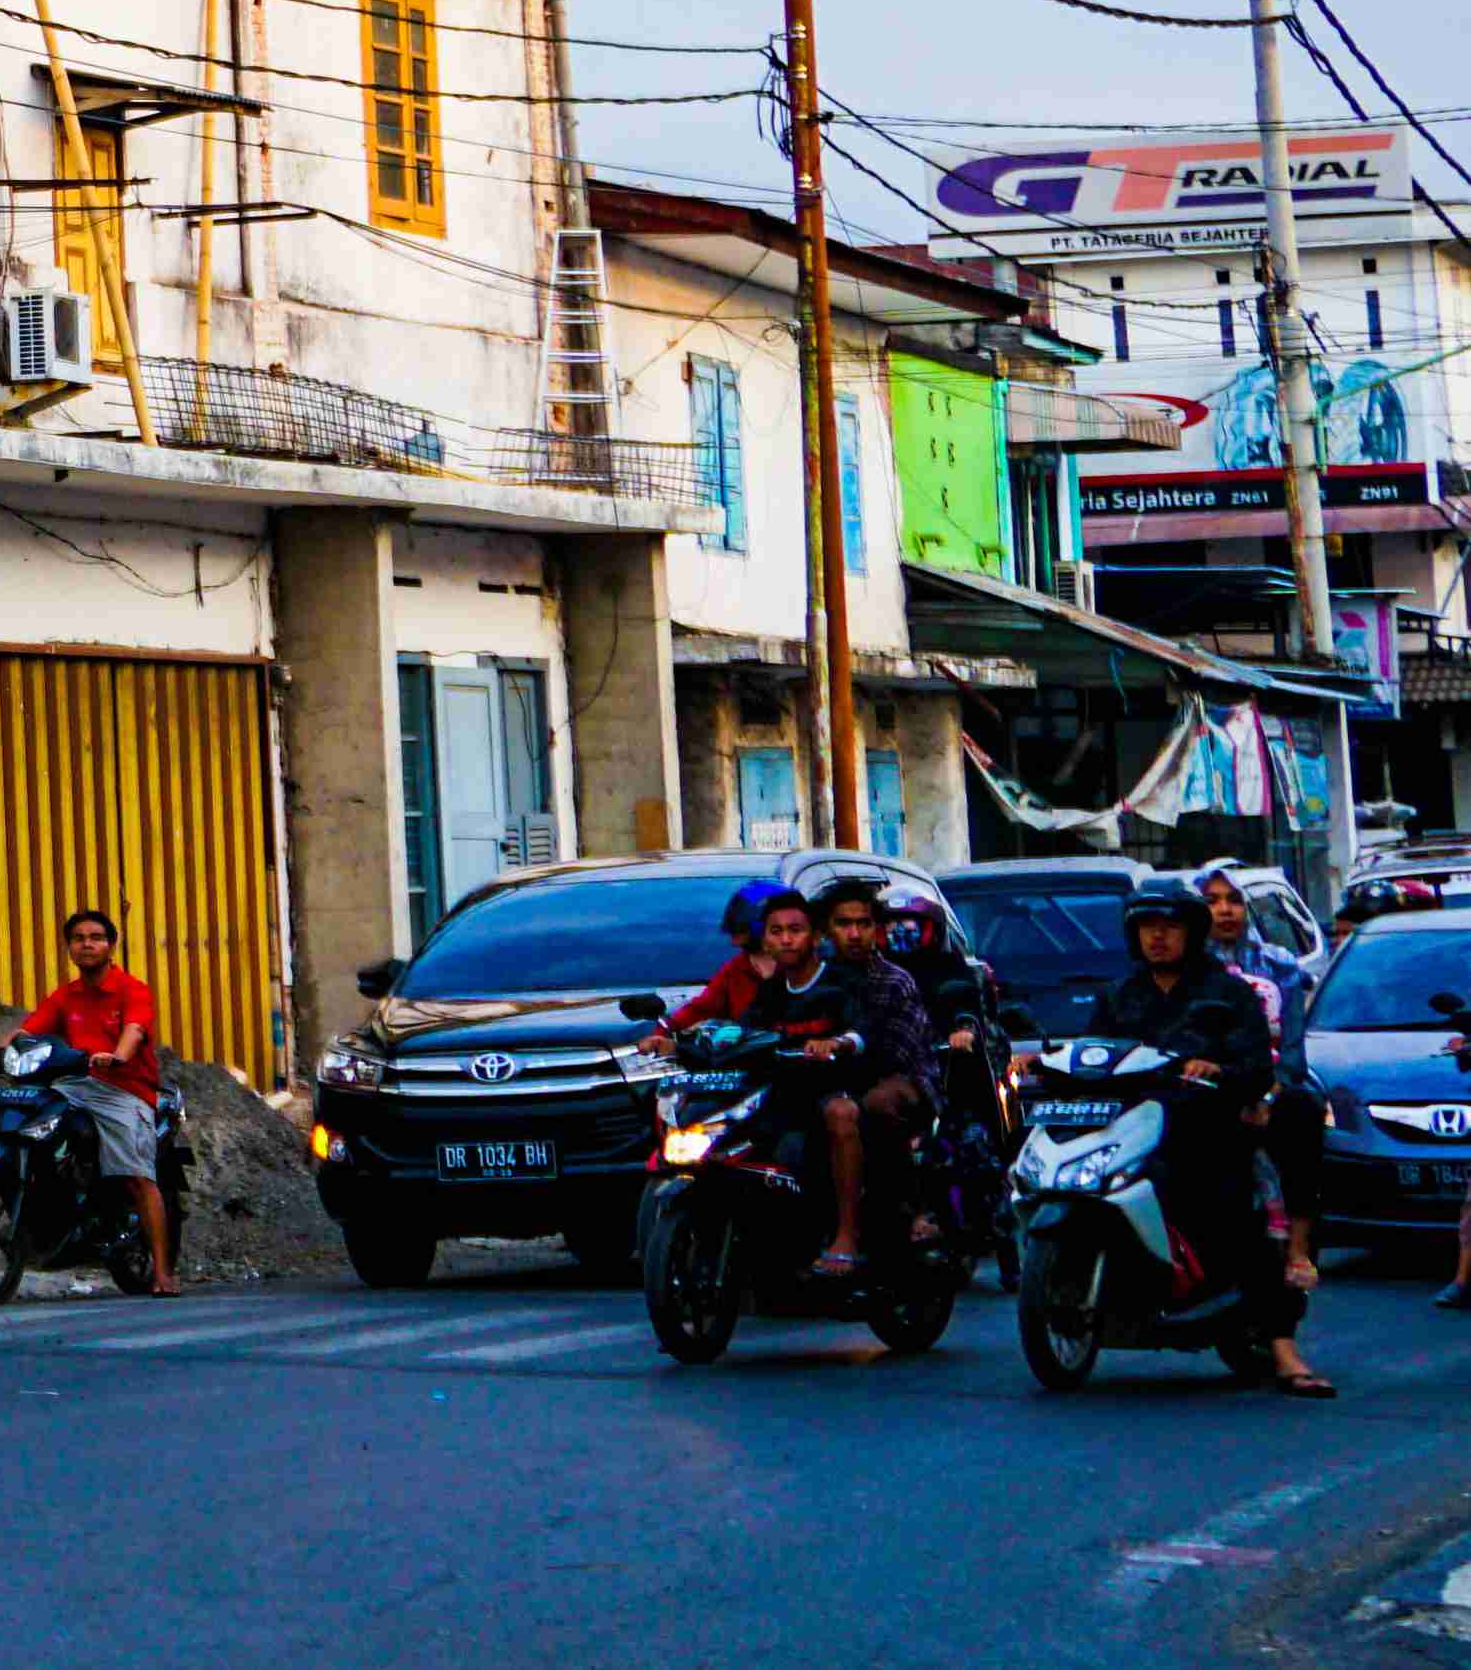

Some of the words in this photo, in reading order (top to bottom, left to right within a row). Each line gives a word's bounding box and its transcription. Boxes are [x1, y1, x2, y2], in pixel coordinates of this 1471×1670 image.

[1182, 159, 1381, 188] RAIAL
[1051, 237, 1075, 250] PT.
[1180, 228, 1269, 243] SEJAHTER
[1112, 487, 1216, 512] Sejahtera
[445, 1147, 467, 1168] DR
[478, 1145, 516, 1167] 1034
[524, 1143, 548, 1166] BH
